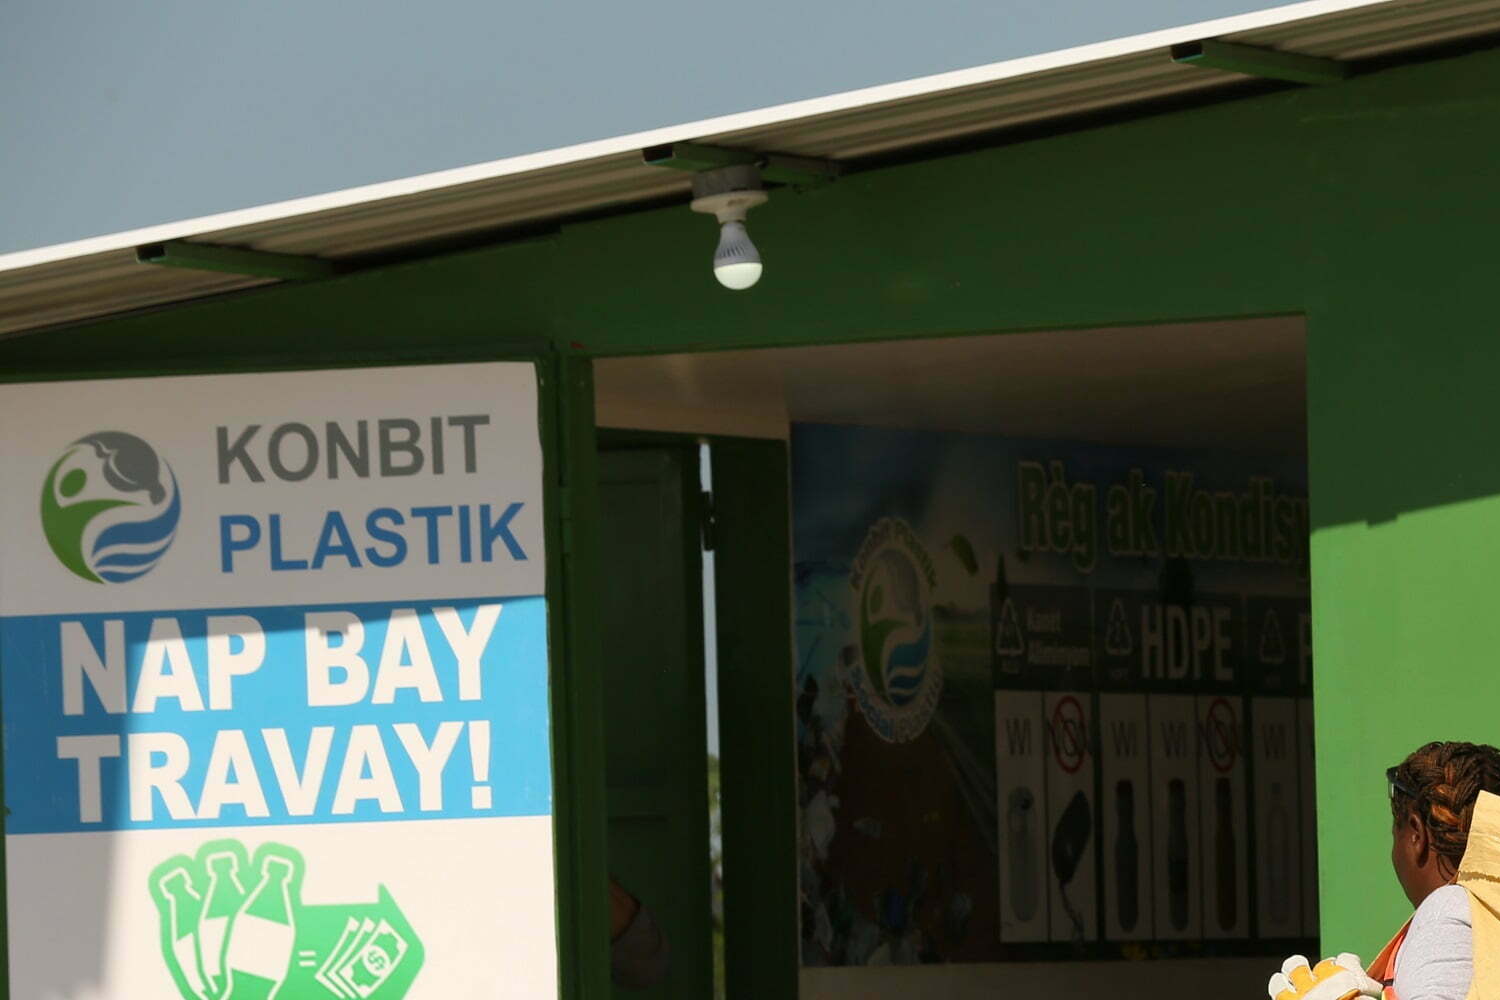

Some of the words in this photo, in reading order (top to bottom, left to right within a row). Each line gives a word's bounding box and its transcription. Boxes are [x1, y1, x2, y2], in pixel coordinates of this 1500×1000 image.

[215, 414, 491, 485] KONBIT
[219, 502, 528, 574] PLASTIK
[1105, 466, 1158, 559] ak
[60, 614, 267, 716] NAP
[304, 604, 503, 707] BAY
[1141, 604, 1233, 681] HDPE
[56, 719, 493, 823] TRAVAY!
